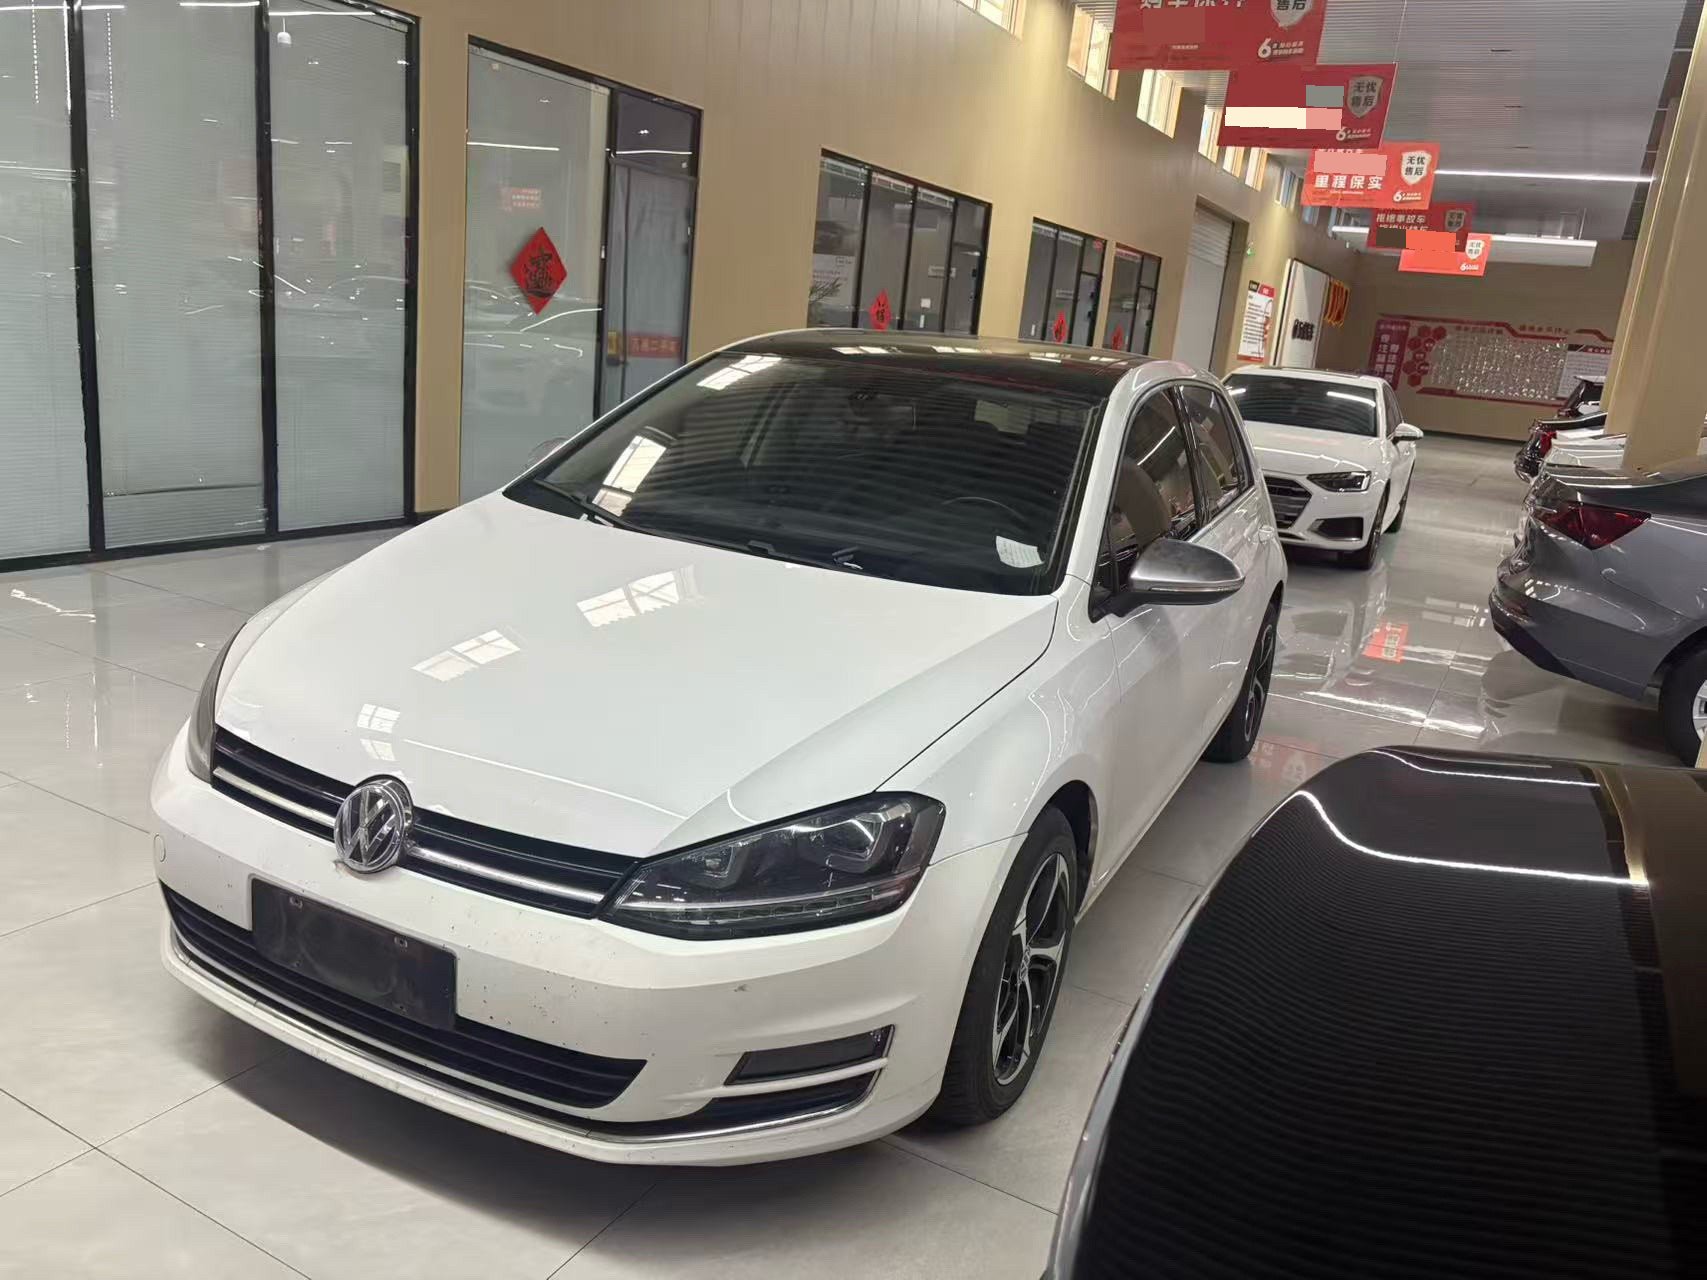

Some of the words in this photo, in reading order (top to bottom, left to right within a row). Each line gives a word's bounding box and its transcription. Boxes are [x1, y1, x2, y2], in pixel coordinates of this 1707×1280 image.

[1257, 37, 1272, 59] 6
[1335, 126, 1347, 141] 6
[1314, 174, 1383, 190] 里程保实
[1393, 190, 1403, 202] 6
